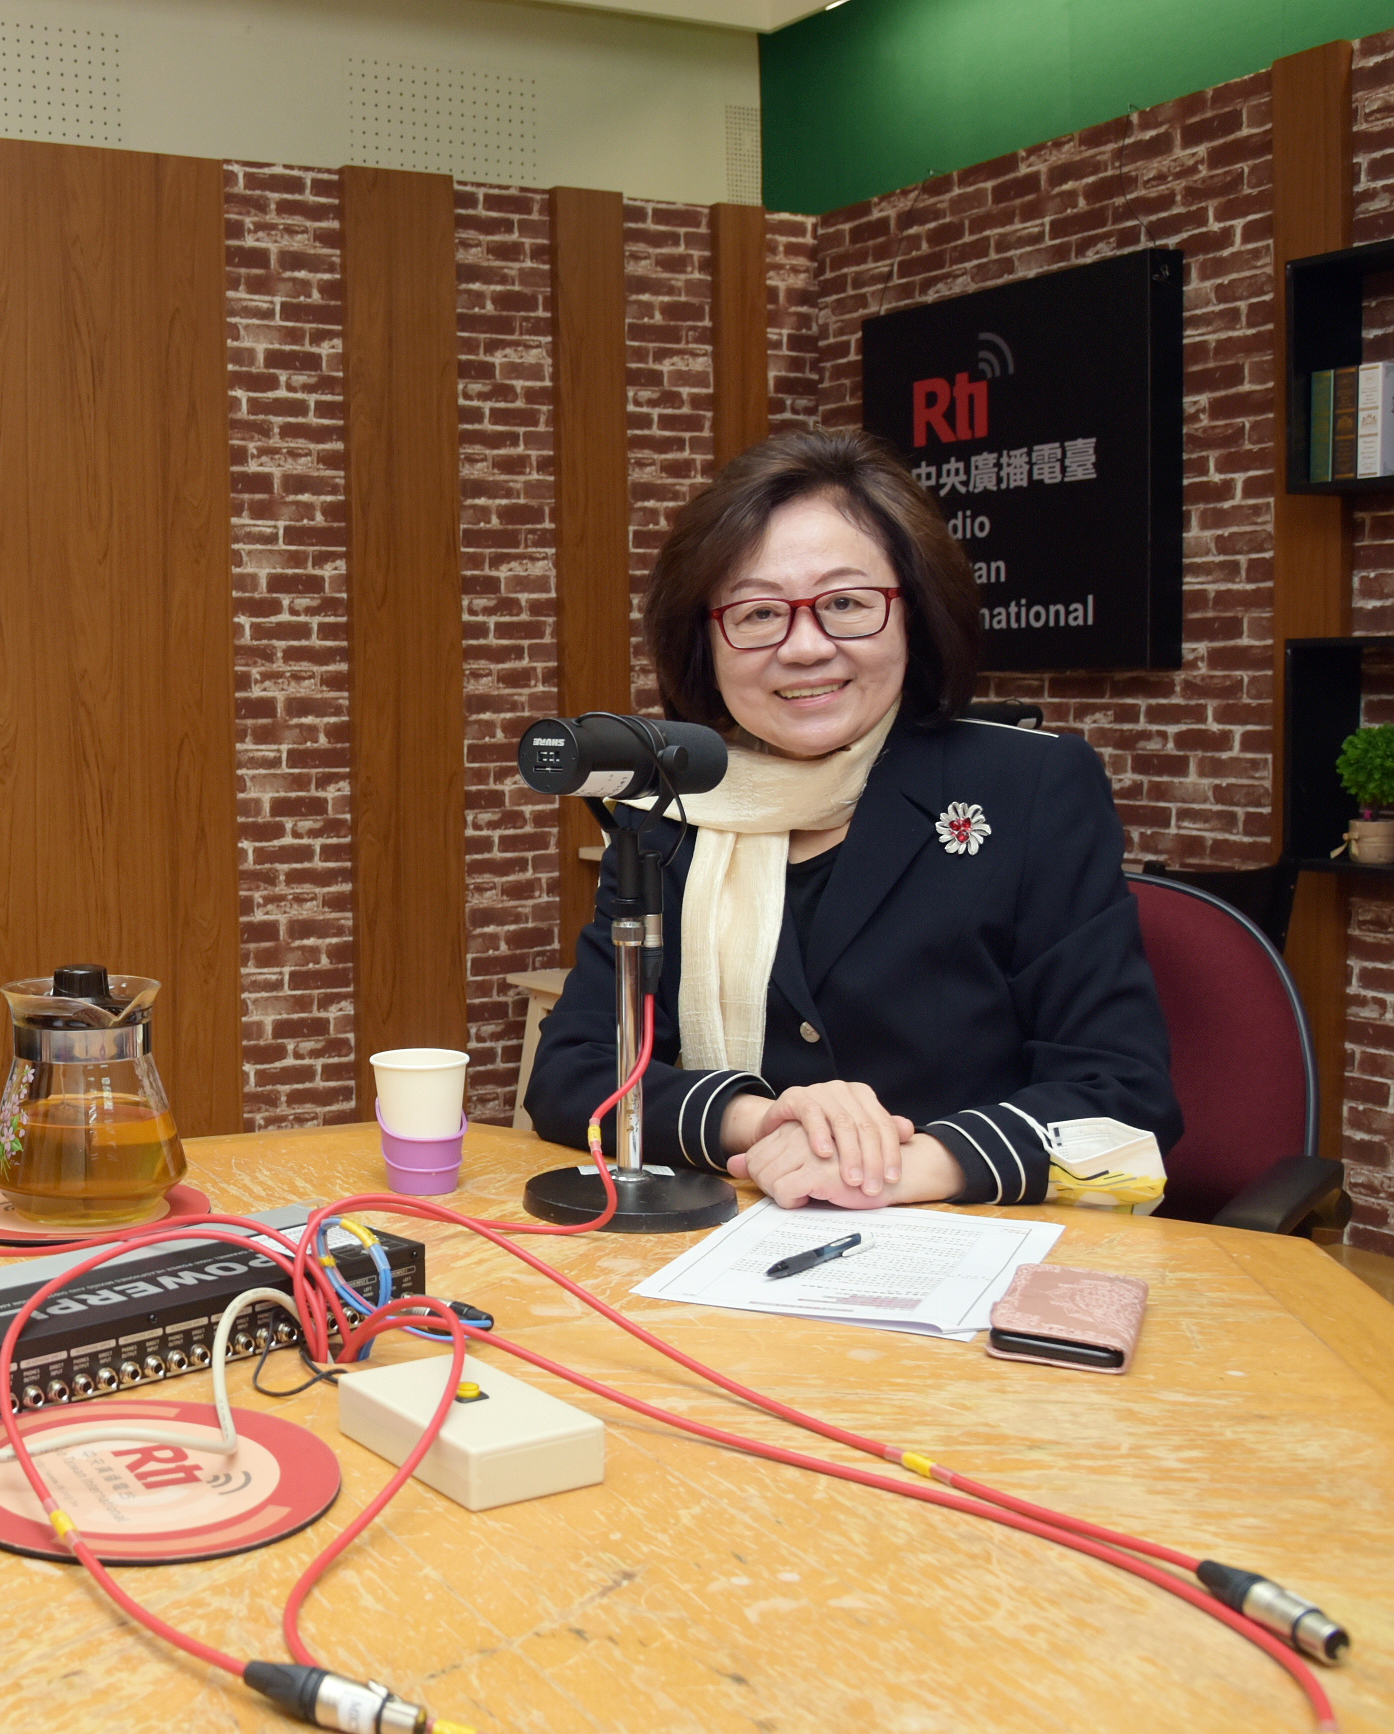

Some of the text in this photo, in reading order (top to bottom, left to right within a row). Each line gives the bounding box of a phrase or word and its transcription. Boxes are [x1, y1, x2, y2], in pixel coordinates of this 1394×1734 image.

[912, 371, 989, 448] Rti
[911, 437, 1097, 497] 中央廣播電臺
[947, 510, 991, 540] dio
[980, 594, 1094, 630] national
[532, 737, 566, 747] SHURE
[110, 1444, 204, 1490] Rti
